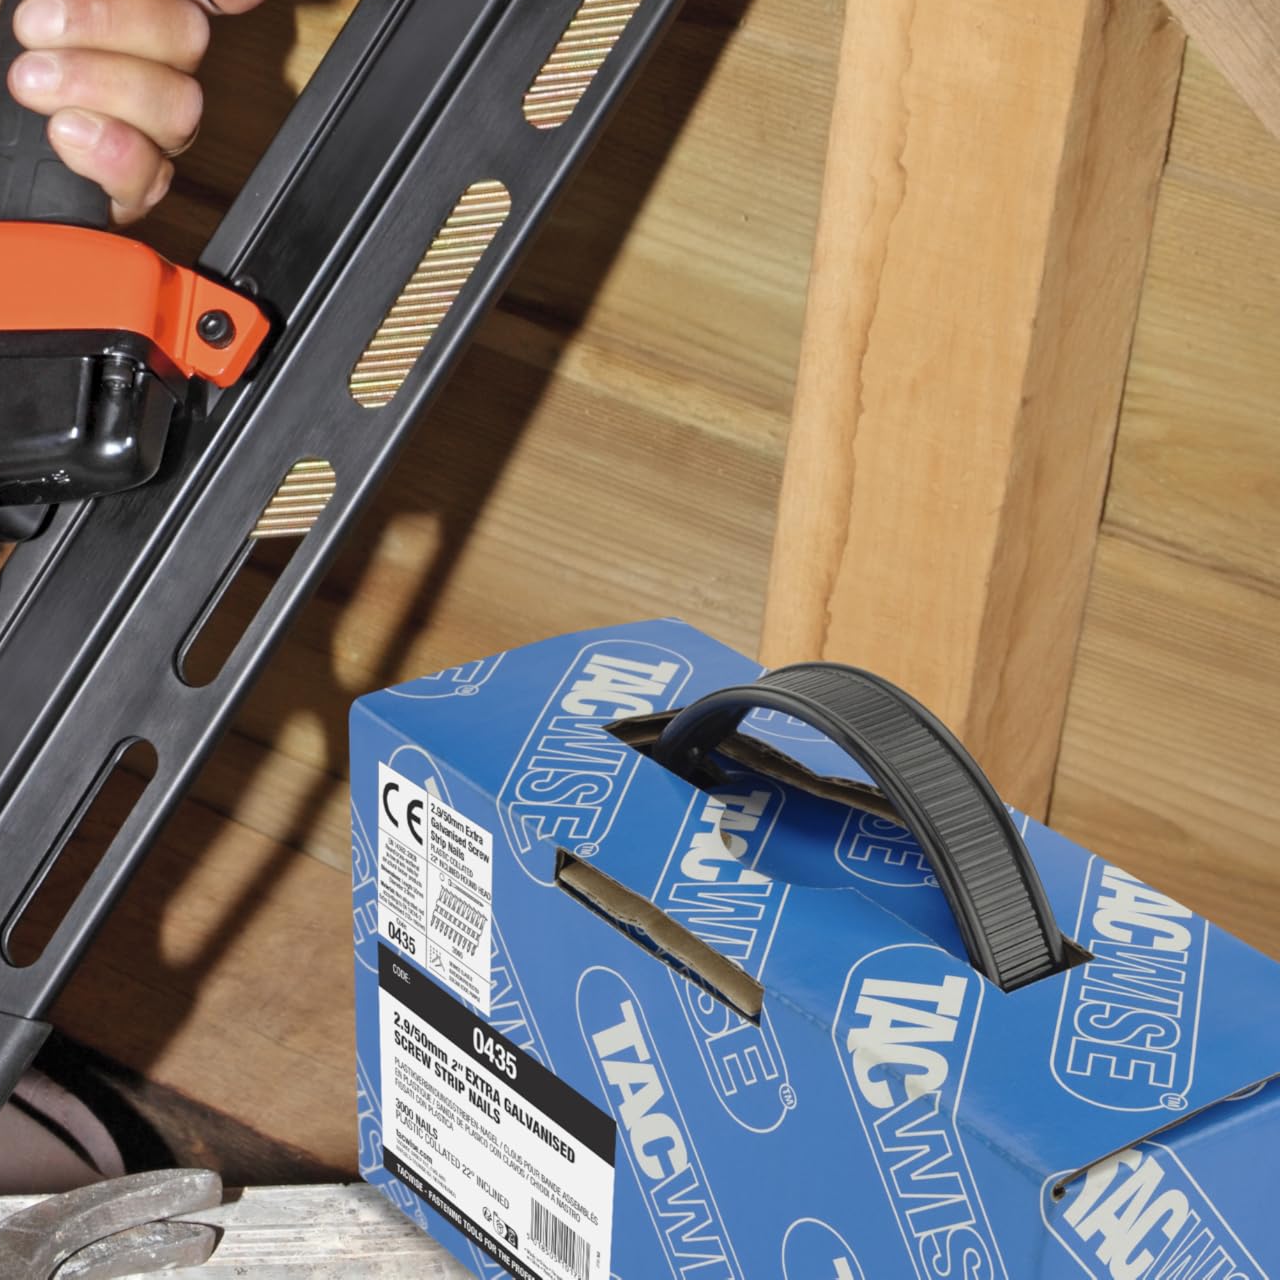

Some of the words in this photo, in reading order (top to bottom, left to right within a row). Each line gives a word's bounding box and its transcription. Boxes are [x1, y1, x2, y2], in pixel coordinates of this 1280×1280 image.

[507, 653, 681, 855] TACWISE
[382, 782, 424, 846] CE
[430, 801, 464, 833] 2.9/50mm
[465, 824, 483, 846] Extra
[430, 815, 466, 849] Galvanised
[467, 840, 489, 865] Screw
[430, 829, 446, 851] Strip
[447, 841, 464, 861] Nails
[388, 919, 415, 956] 0435
[393, 1027, 431, 1071] SCREW
[433, 1059, 465, 1098] STRIP
[468, 1086, 501, 1126] NAILS
[472, 1023, 517, 1083] 0435
[393, 1008, 448, 1066] 2.9/50mm
[465, 1064, 500, 1107] EXTRA
[503, 1094, 575, 1166] GALVANISED
[395, 1095, 413, 1121] 3000
[415, 1111, 438, 1142] NAILS
[394, 1106, 423, 1141] PLASTIC
[424, 1130, 460, 1172] COLLATED
[476, 1173, 510, 1212] INCLINED
[846, 974, 995, 1280] TACWIS
[427, 1187, 461, 1226] FASTENING
[462, 1217, 483, 1244] TOOLS
[483, 1235, 496, 1255] FOR
[497, 1246, 511, 1267] THE
